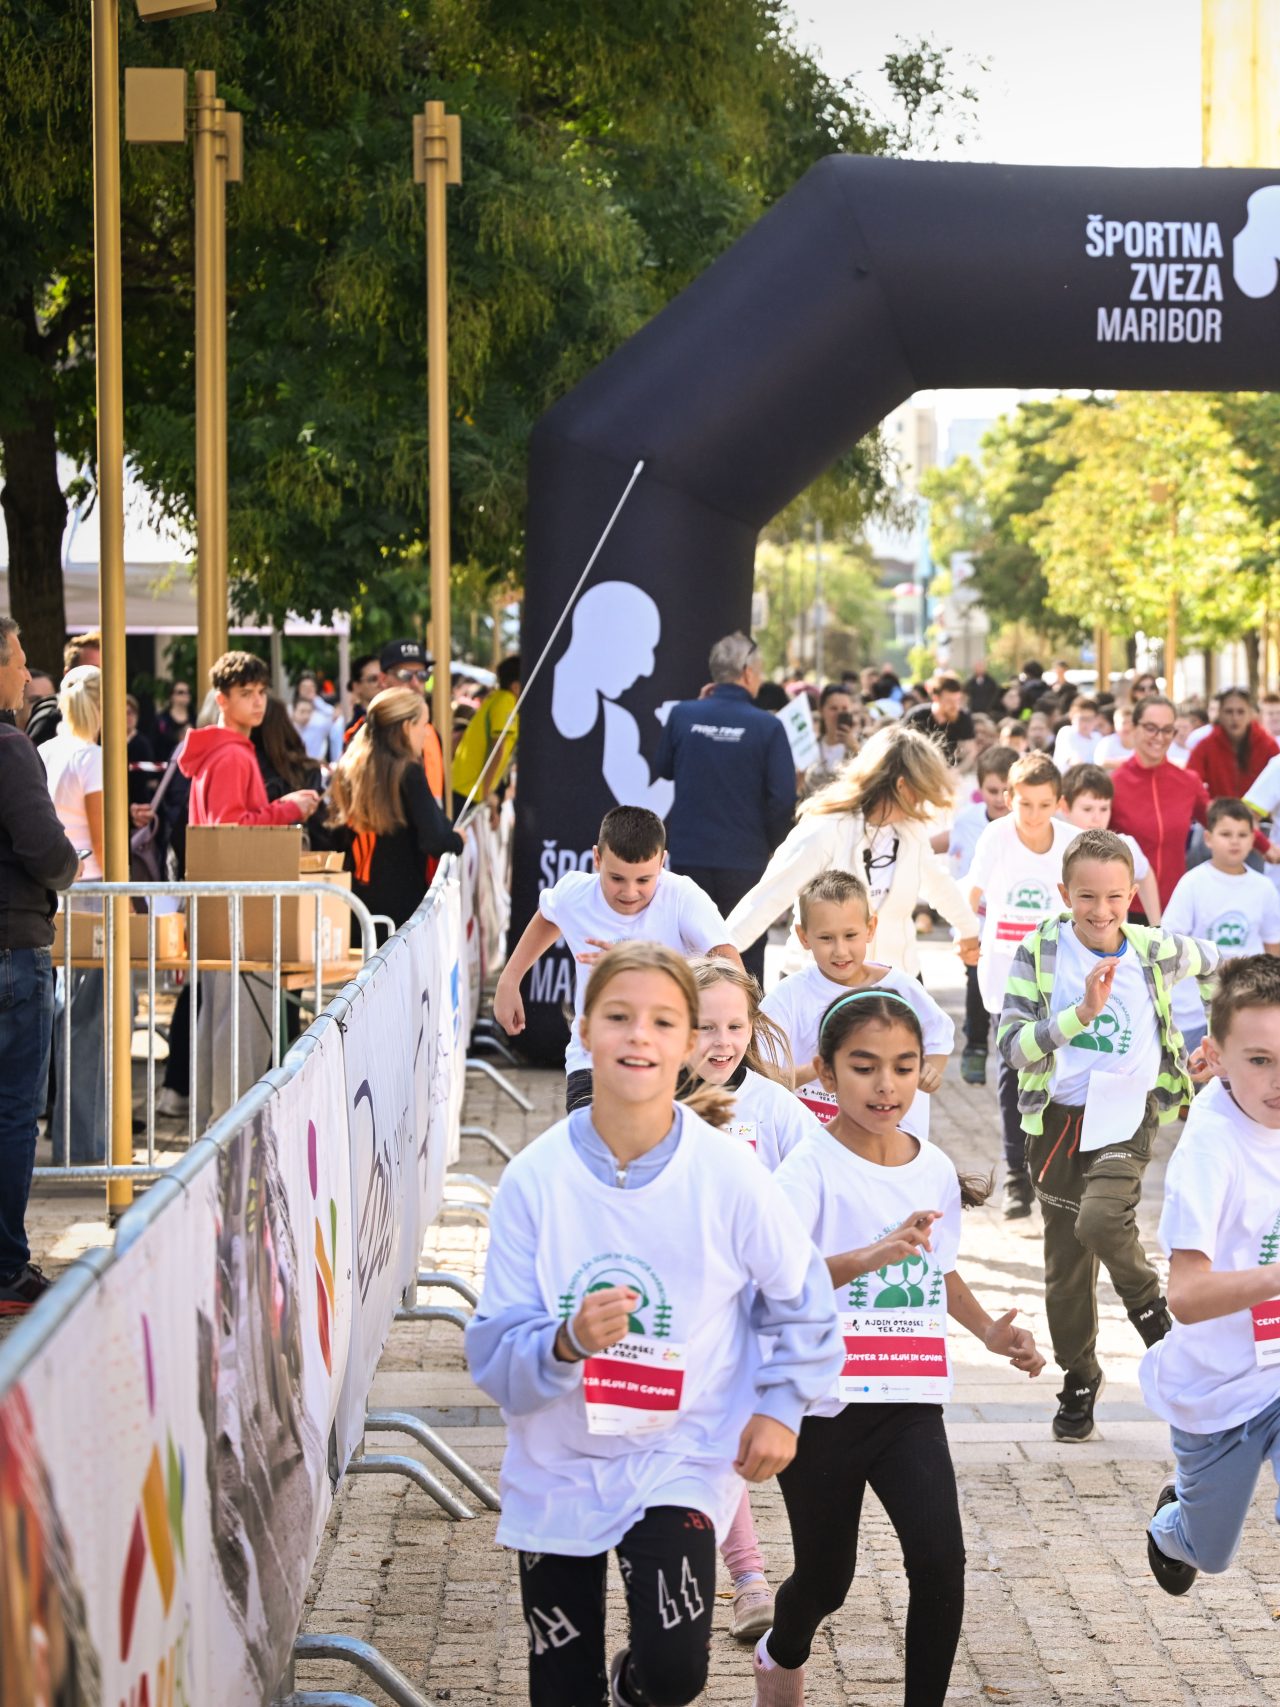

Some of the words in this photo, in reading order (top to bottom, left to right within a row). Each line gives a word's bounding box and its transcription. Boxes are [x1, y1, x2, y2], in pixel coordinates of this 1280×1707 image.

[1085, 214, 1224, 258] ŠPORTNA
[1129, 263, 1224, 302] ZVEZA
[1097, 307, 1223, 343] MARIBOR
[890, 1353, 909, 1361] SLUH
[910, 1353, 919, 1361] IN
[588, 1377, 599, 1386] ZA
[601, 1378, 626, 1389] SLUH
[627, 1381, 640, 1392] IN
